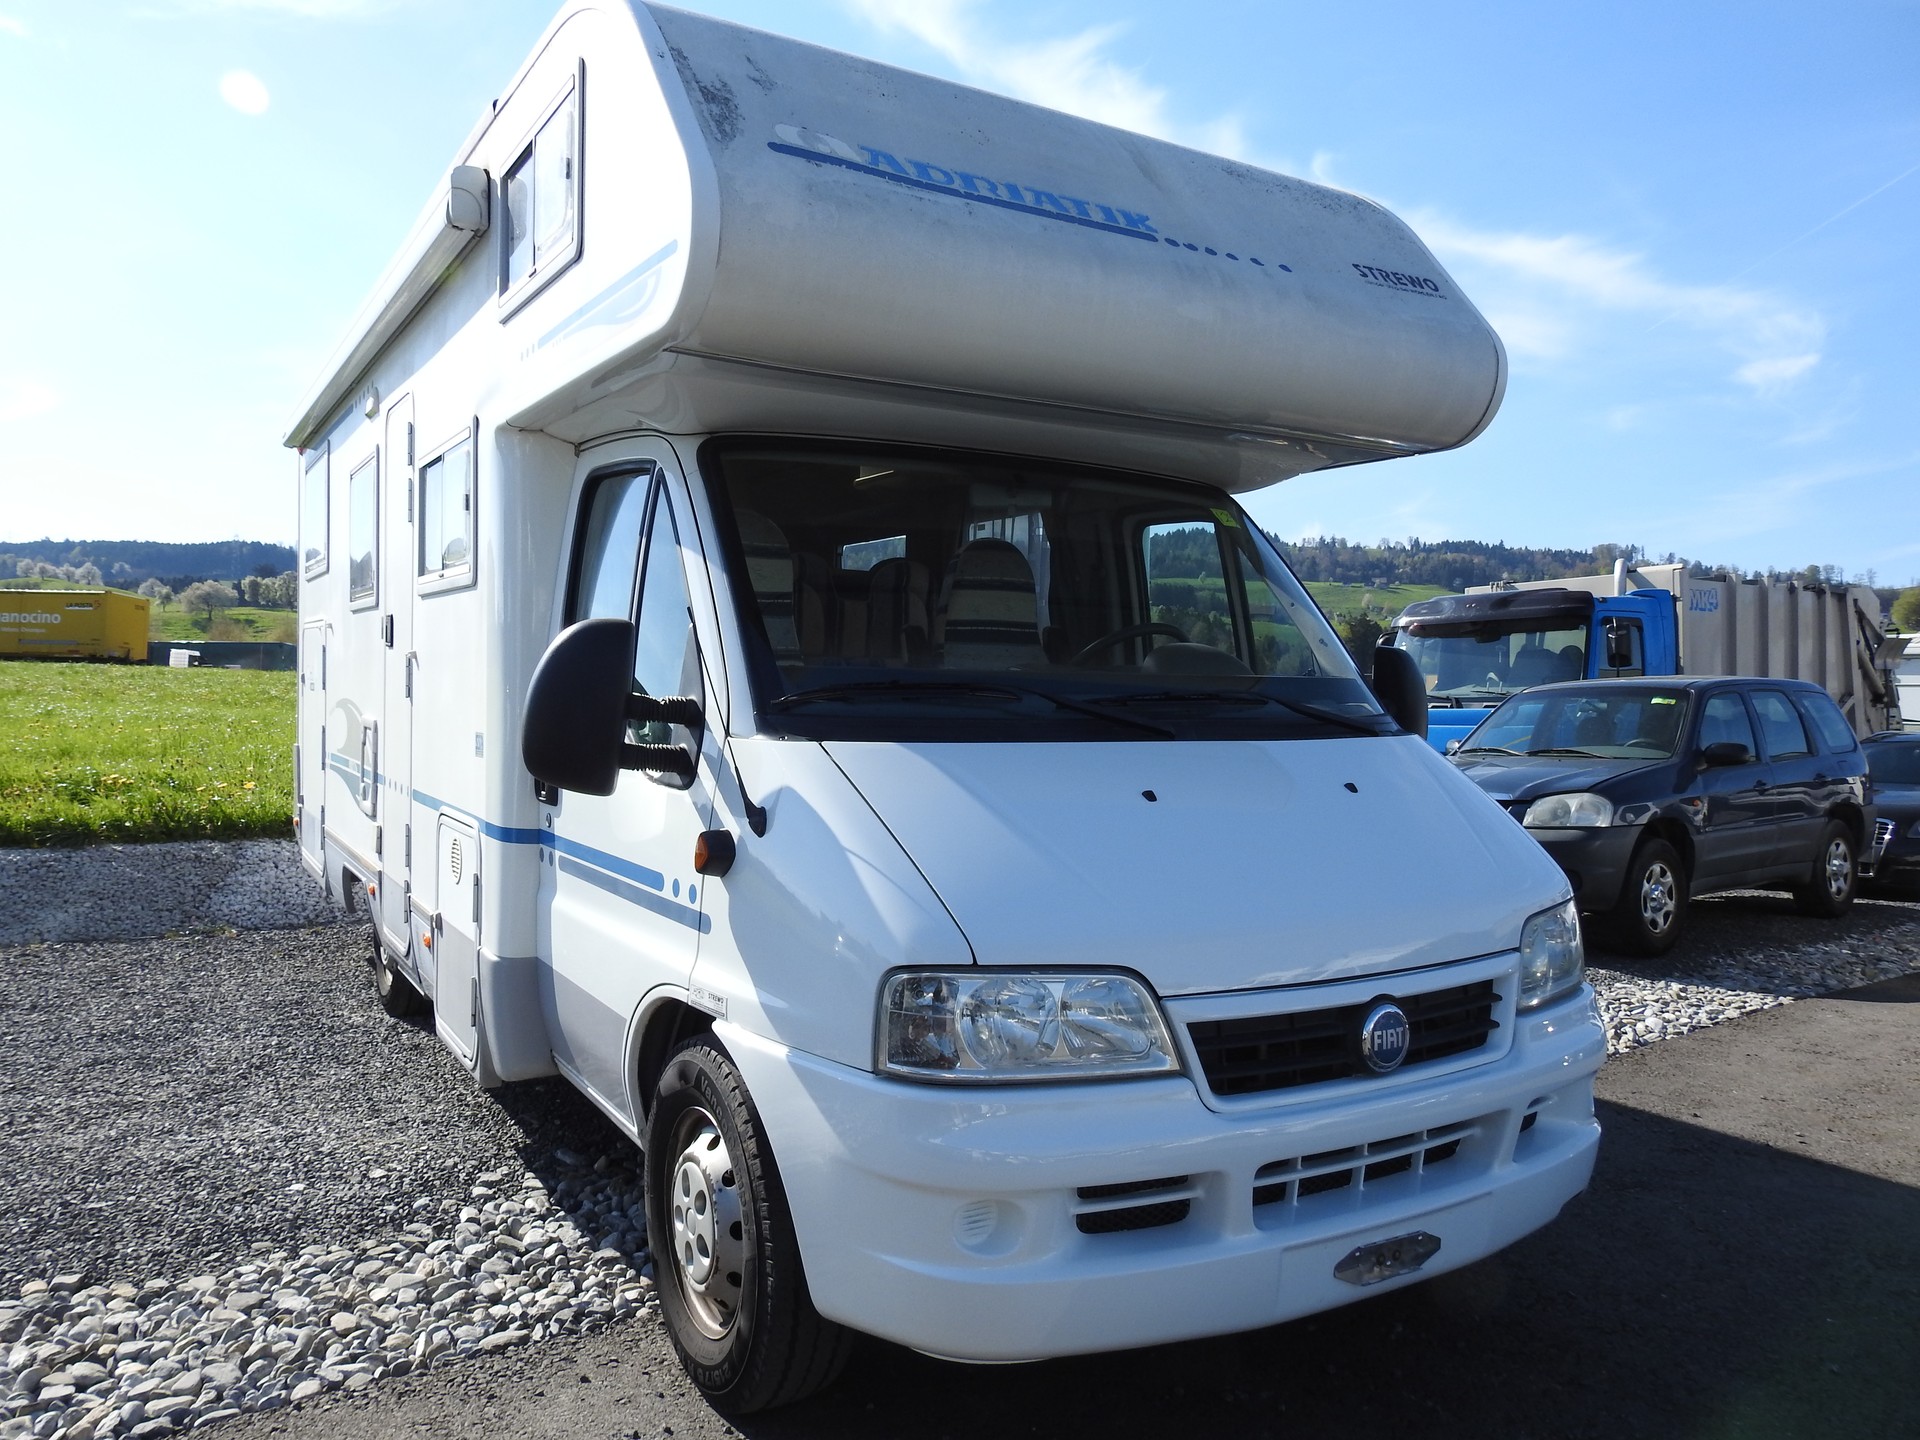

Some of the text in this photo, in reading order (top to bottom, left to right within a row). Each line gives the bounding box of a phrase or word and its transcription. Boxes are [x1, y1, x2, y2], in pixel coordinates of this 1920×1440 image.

[857, 145, 1159, 234] ADRIATIK
[1351, 263, 1440, 293] STREWO
[1373, 1026, 1404, 1051] FIAT
